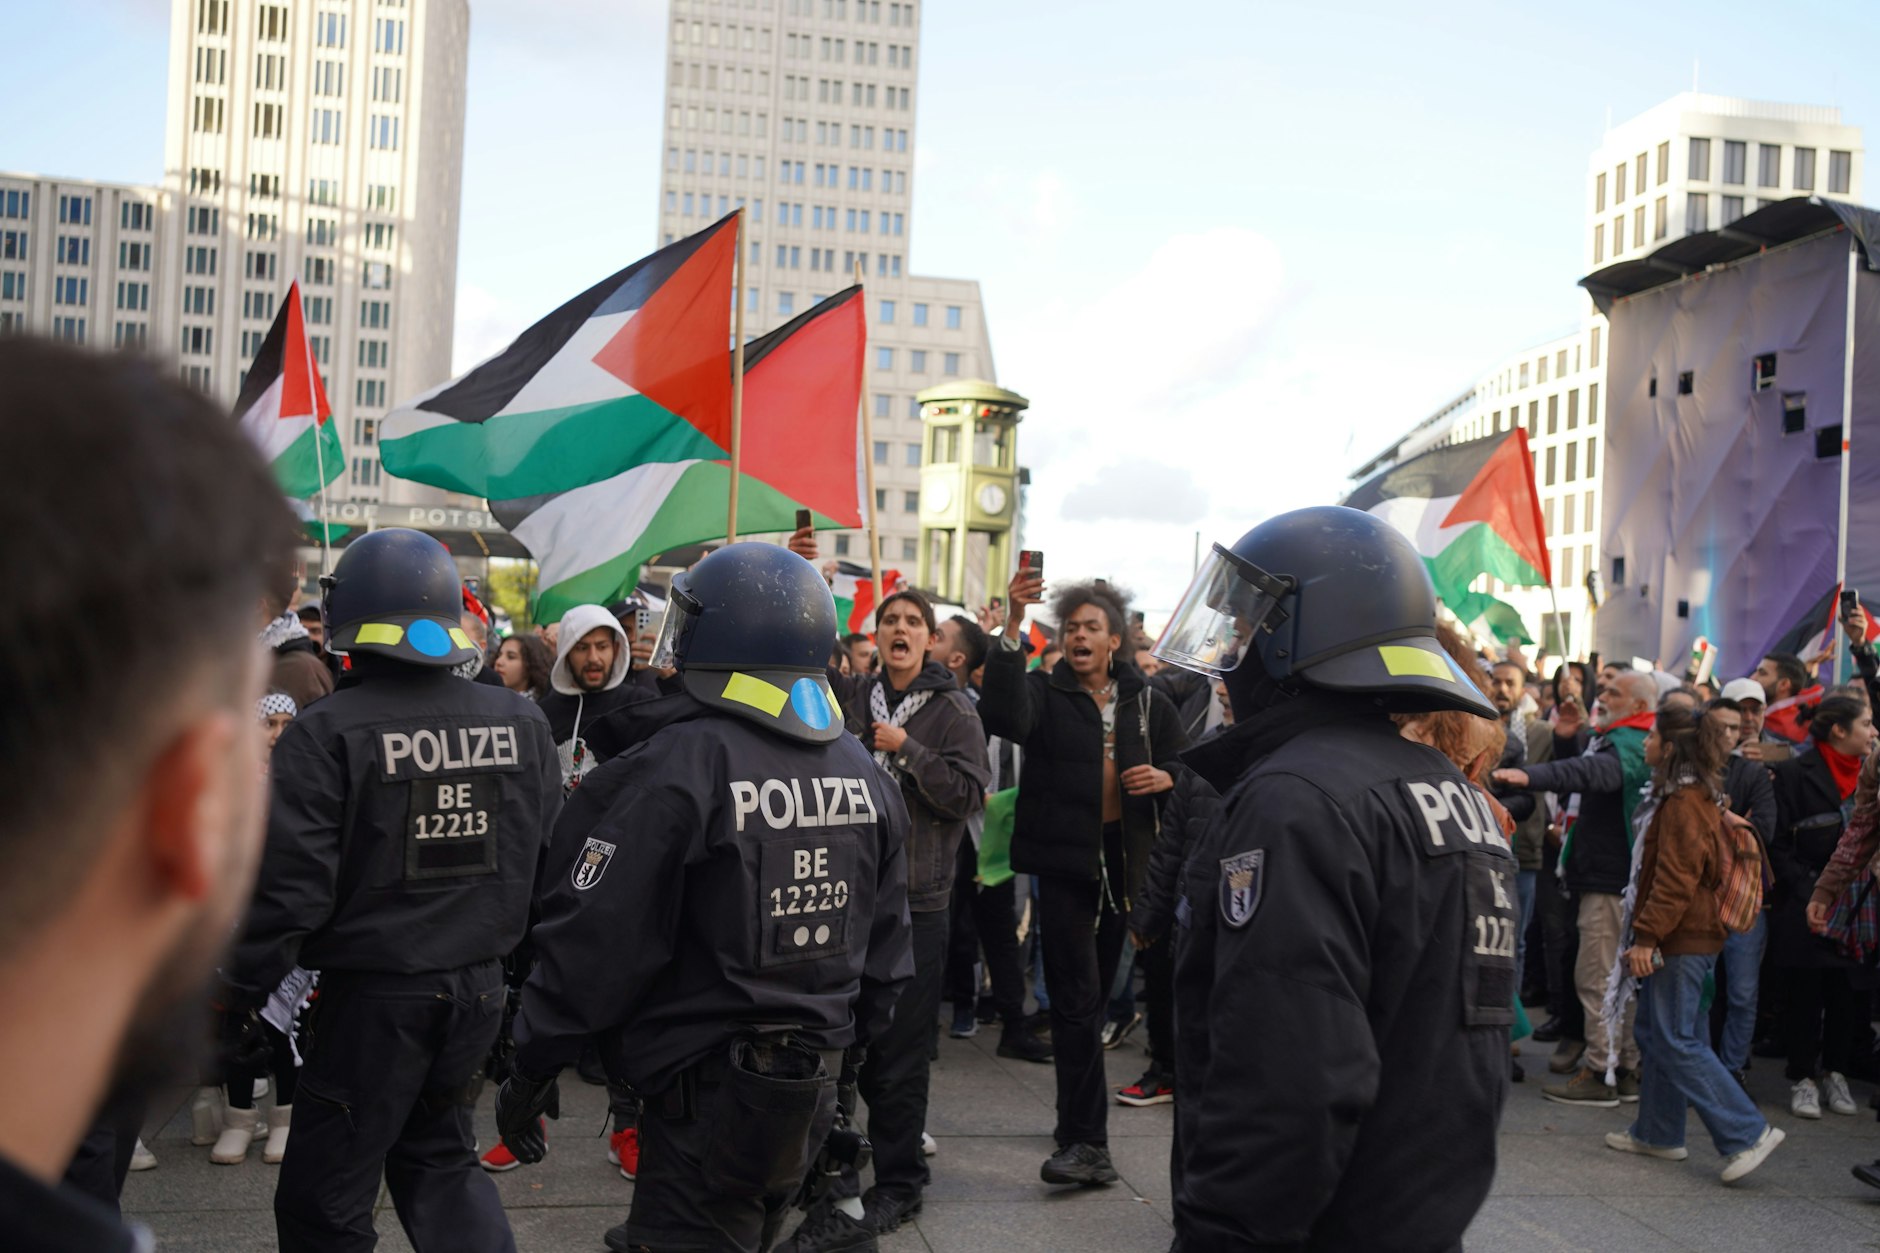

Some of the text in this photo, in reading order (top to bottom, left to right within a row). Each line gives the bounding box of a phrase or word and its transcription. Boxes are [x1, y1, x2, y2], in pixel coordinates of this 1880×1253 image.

[382, 726, 518, 775] POLIZEI
[437, 783, 472, 810] BE
[729, 777, 877, 831] POLIZEI
[415, 810, 488, 839] 12213
[586, 840, 612, 856] POLIZEI
[794, 847, 829, 880] BE
[770, 880, 849, 917] 12220
